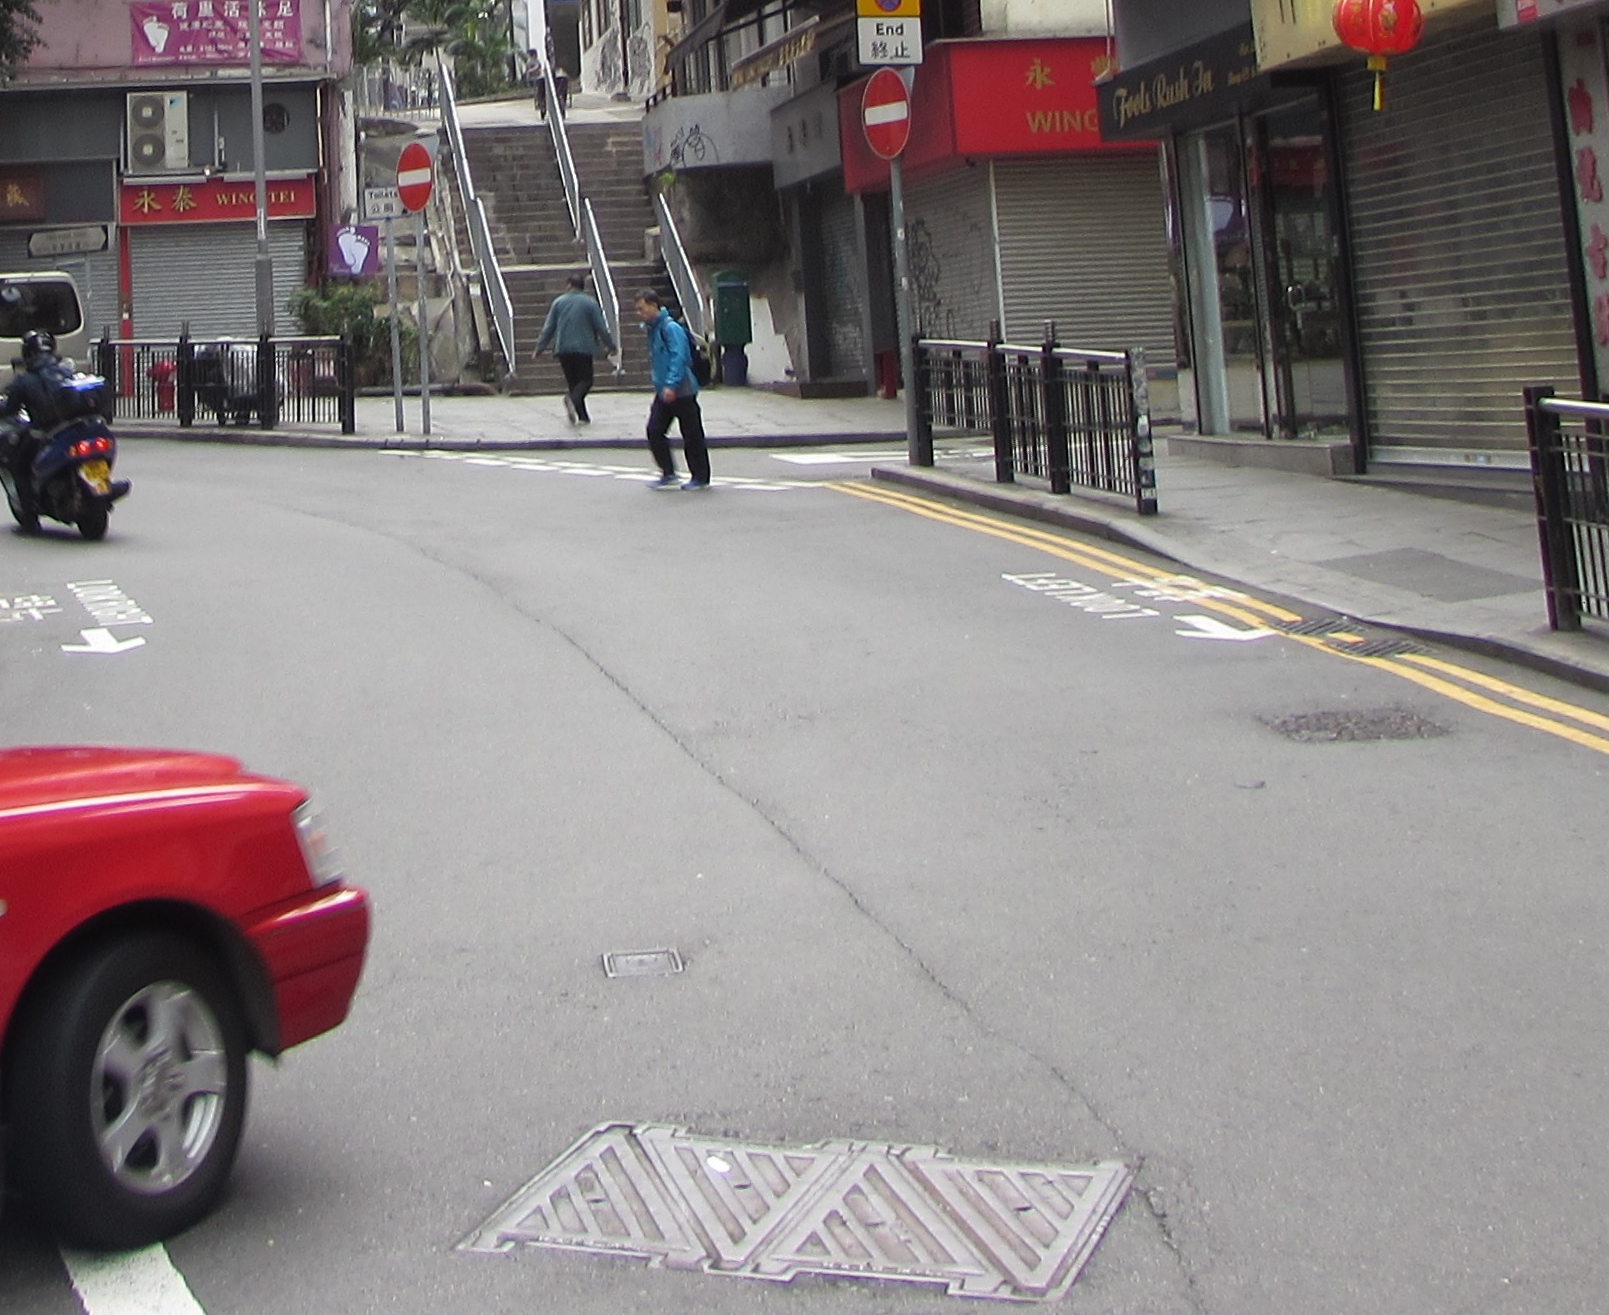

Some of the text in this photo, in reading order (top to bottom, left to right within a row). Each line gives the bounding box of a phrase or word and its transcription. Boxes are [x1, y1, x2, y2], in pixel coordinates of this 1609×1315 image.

[876, 23, 905, 37] End
[870, 42, 911, 60] 終止
[1112, 80, 1153, 129] Fools
[1152, 64, 1190, 110] Rush
[1191, 59, 1215, 97] In
[132, 187, 198, 214] 永泰
[268, 190, 296, 203] TEI
